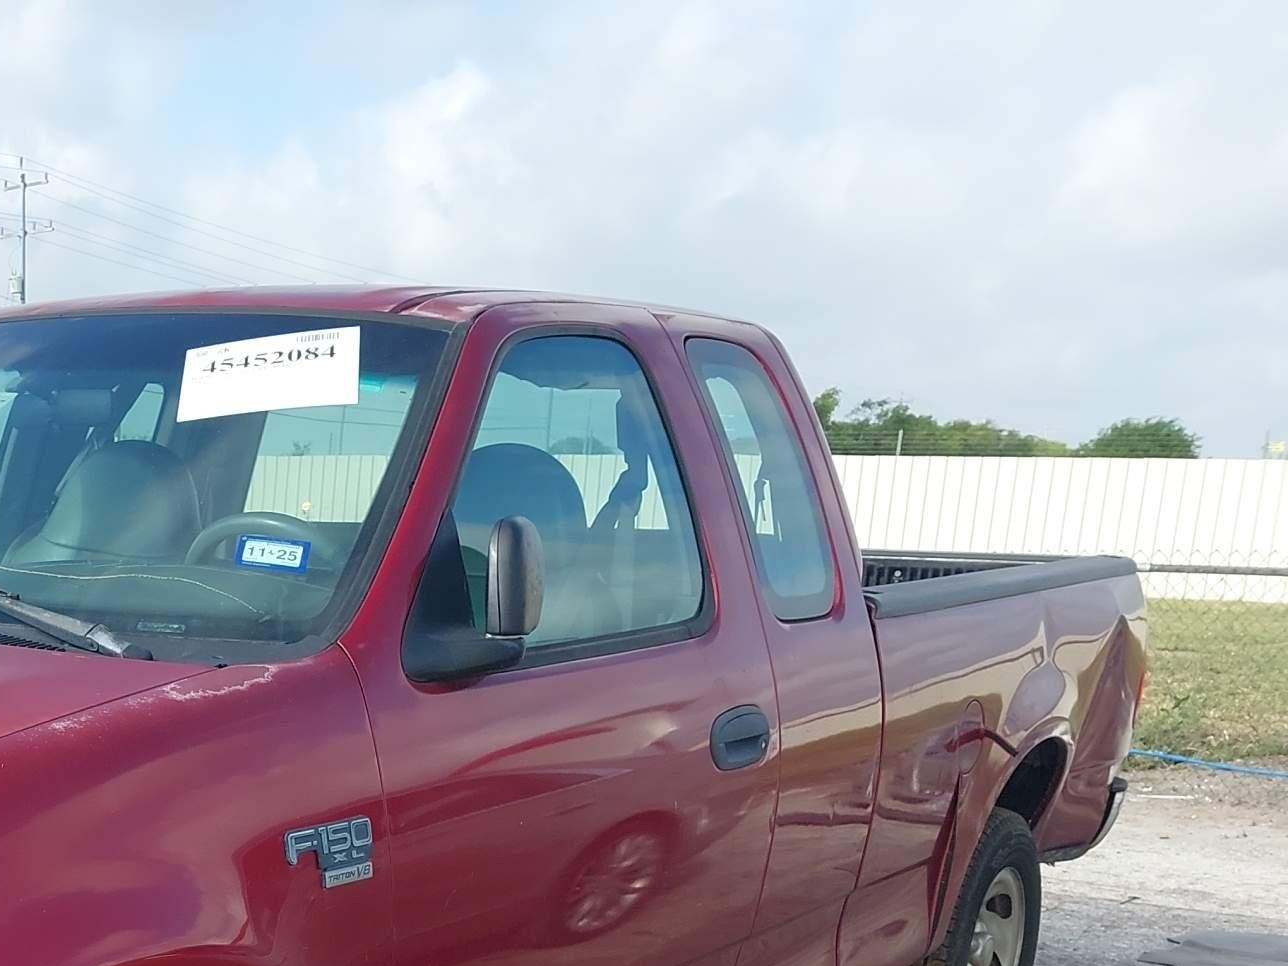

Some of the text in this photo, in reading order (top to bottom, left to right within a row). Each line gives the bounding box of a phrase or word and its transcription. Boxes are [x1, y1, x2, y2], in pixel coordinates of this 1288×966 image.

[202, 344, 337, 374] 45452084
[333, 850, 365, 863] XL
[327, 864, 371, 883] TRITON V8
